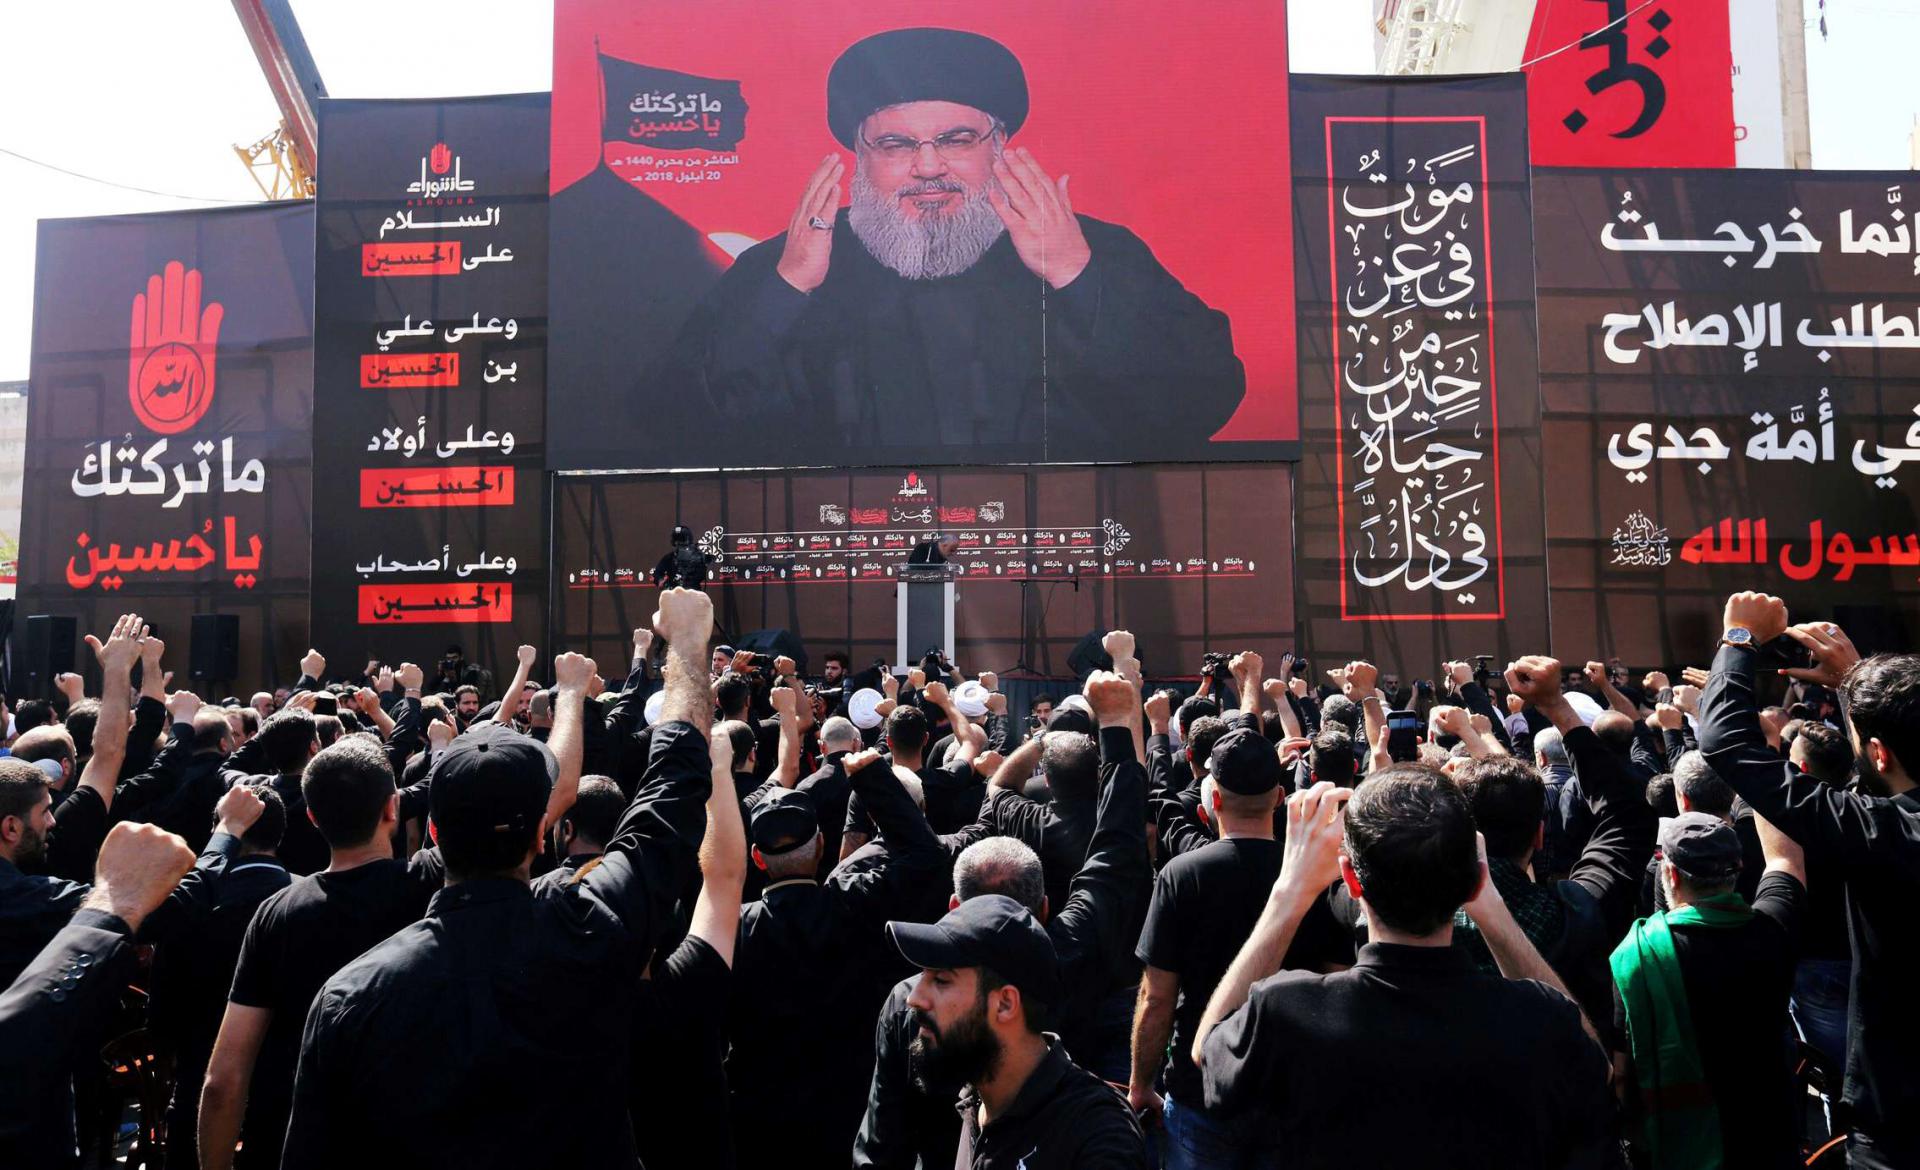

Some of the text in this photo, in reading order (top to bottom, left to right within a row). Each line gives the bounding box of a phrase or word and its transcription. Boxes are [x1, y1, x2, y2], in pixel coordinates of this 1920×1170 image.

[626, 156, 653, 165] 1440
[645, 172, 673, 181] 2018
[656, 158, 683, 169] محرم
[685, 158, 701, 167] من
[703, 155, 738, 167] العاشر
[706, 171, 721, 180] 20
[366, 243, 514, 272] على الحسين
[376, 312, 518, 352] وعلى علي
[1601, 300, 1920, 373] طلب الإصلاح
[367, 357, 518, 384] بن الحسين
[367, 415, 515, 459] وعلى أولاد
[1607, 422, 1731, 484] جدي
[376, 469, 504, 505] الحسين
[355, 544, 517, 579] وعلى أصحاب
[1679, 516, 1920, 581] سول الله
[373, 584, 501, 620] الحسين
